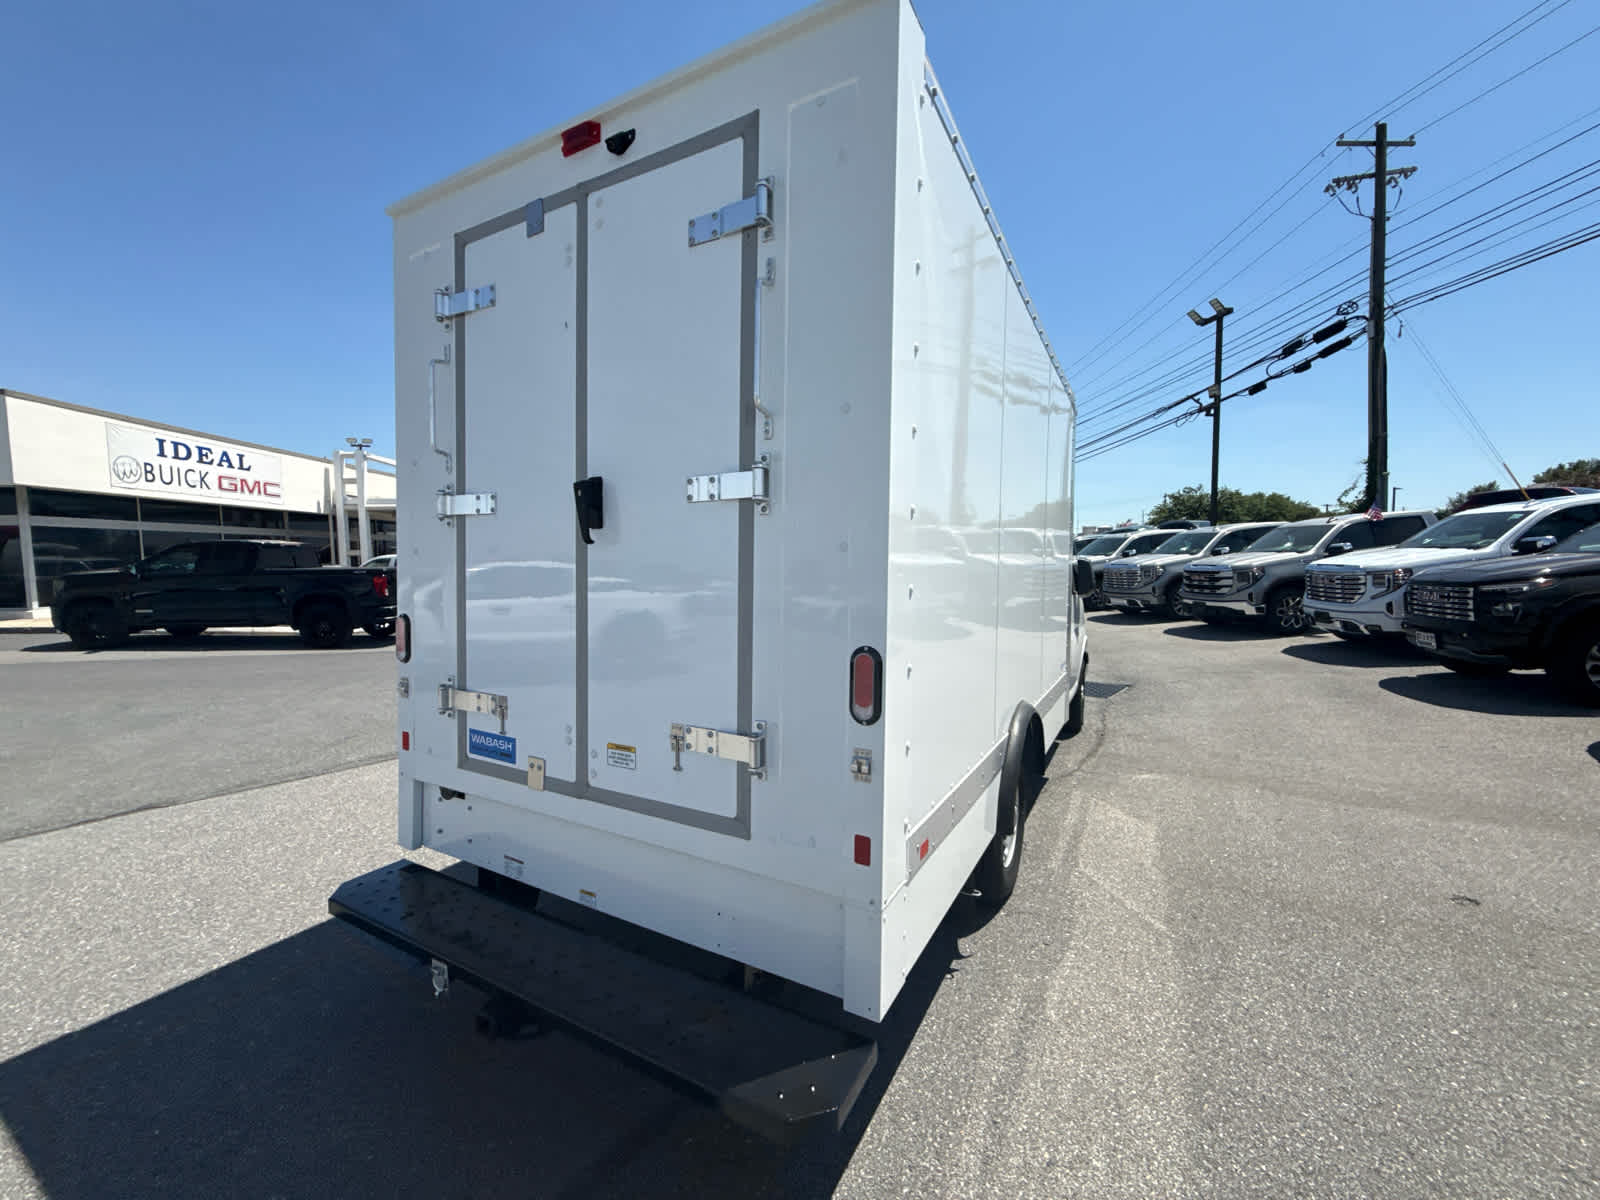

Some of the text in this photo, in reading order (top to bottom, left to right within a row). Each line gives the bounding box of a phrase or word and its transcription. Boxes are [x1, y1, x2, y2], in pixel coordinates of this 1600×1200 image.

[155, 437, 252, 471] IDEAL
[143, 462, 281, 498] BUICK GMC
[471, 733, 513, 752] WABASH
